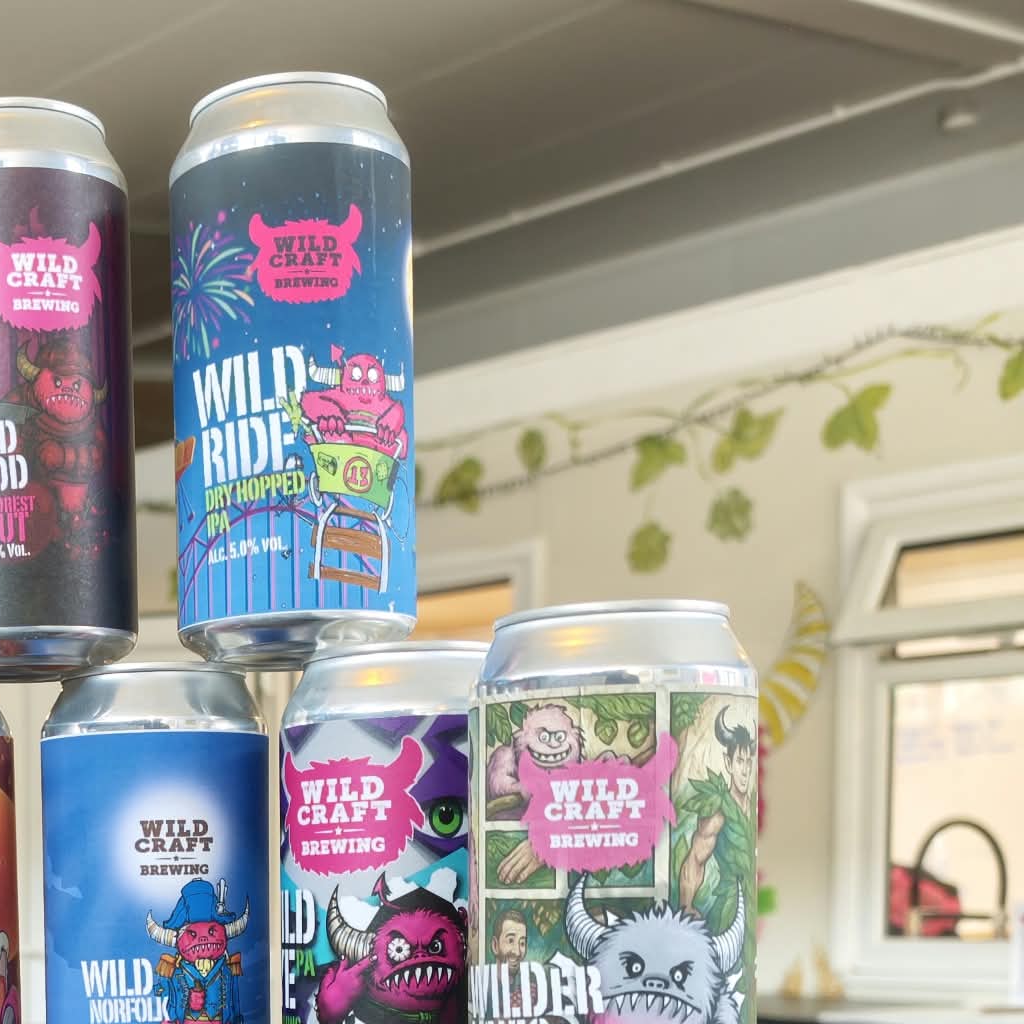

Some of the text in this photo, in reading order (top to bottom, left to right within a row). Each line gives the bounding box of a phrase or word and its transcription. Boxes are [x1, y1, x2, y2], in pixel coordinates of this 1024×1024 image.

[273, 235, 337, 253] WILD
[11, 253, 78, 274] WILD
[269, 252, 342, 268] CRAFT
[7, 272, 83, 291] CRAFT
[274, 277, 338, 289] BREWING
[13, 299, 80, 313] BREWING
[192, 345, 307, 428] WILD
[205, 471, 306, 513] DRY HOPPED
[206, 510, 231, 538] IPA
[229, 537, 260, 559] 5.0%
[301, 775, 384, 804] WILD
[549, 777, 638, 803] WILD
[297, 799, 392, 826] CRAFT
[544, 800, 646, 822] CRAFT
[139, 819, 209, 837] WILD
[134, 837, 213, 853] CRAFT
[301, 837, 385, 856] BREWING
[550, 832, 639, 849] BREWING
[139, 863, 209, 876] BREWING
[81, 958, 153, 997] WILD
[471, 961, 604, 1018] WILDER
[90, 996, 170, 1024] NORFOLK
